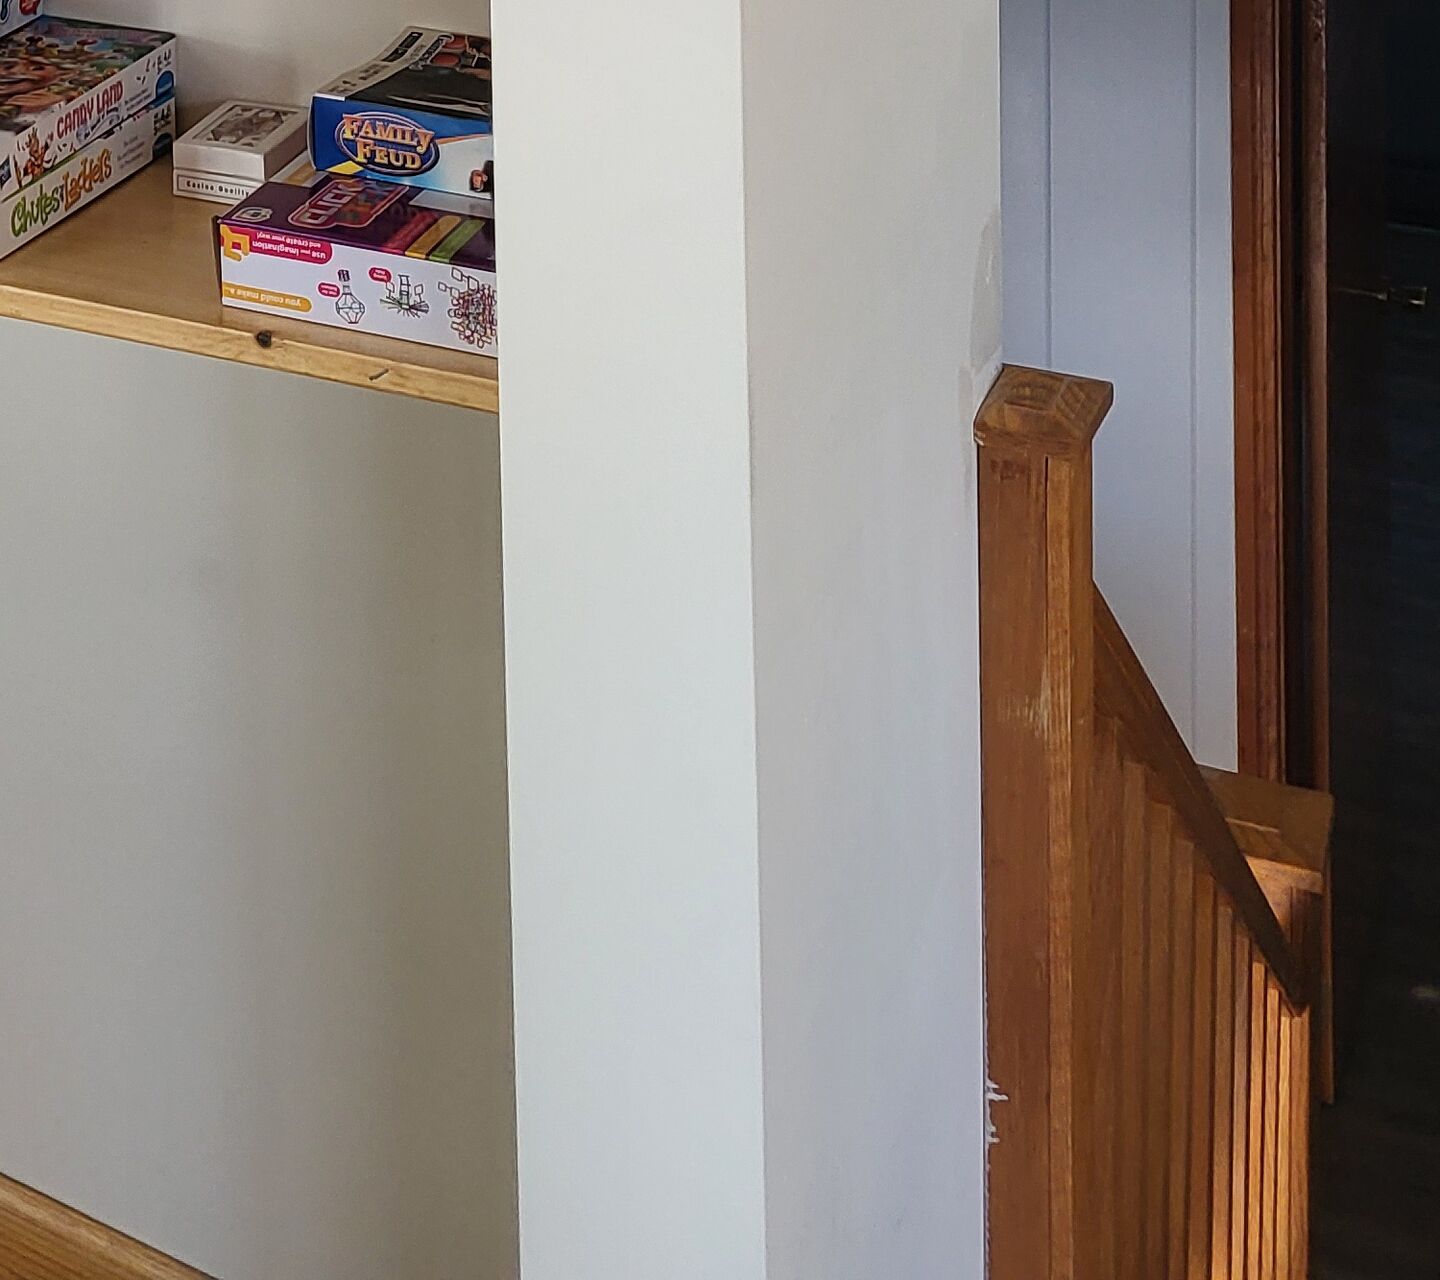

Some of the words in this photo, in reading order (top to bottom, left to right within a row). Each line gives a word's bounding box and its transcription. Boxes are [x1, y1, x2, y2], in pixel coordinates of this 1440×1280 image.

[56, 95, 95, 139] CANDY
[96, 79, 124, 115] LAND
[343, 113, 436, 152] FAMILY
[355, 139, 422, 171] FEUD
[11, 183, 60, 238] Chutes
[62, 148, 112, 212] Ladders
[186, 180, 215, 191] Casino
[218, 185, 250, 197] Quality
[286, 237, 309, 247] create
[309, 240, 322, 249] and
[311, 250, 326, 259] use
[237, 289, 259, 299] make
[260, 294, 284, 304] could
[285, 298, 302, 307] you
